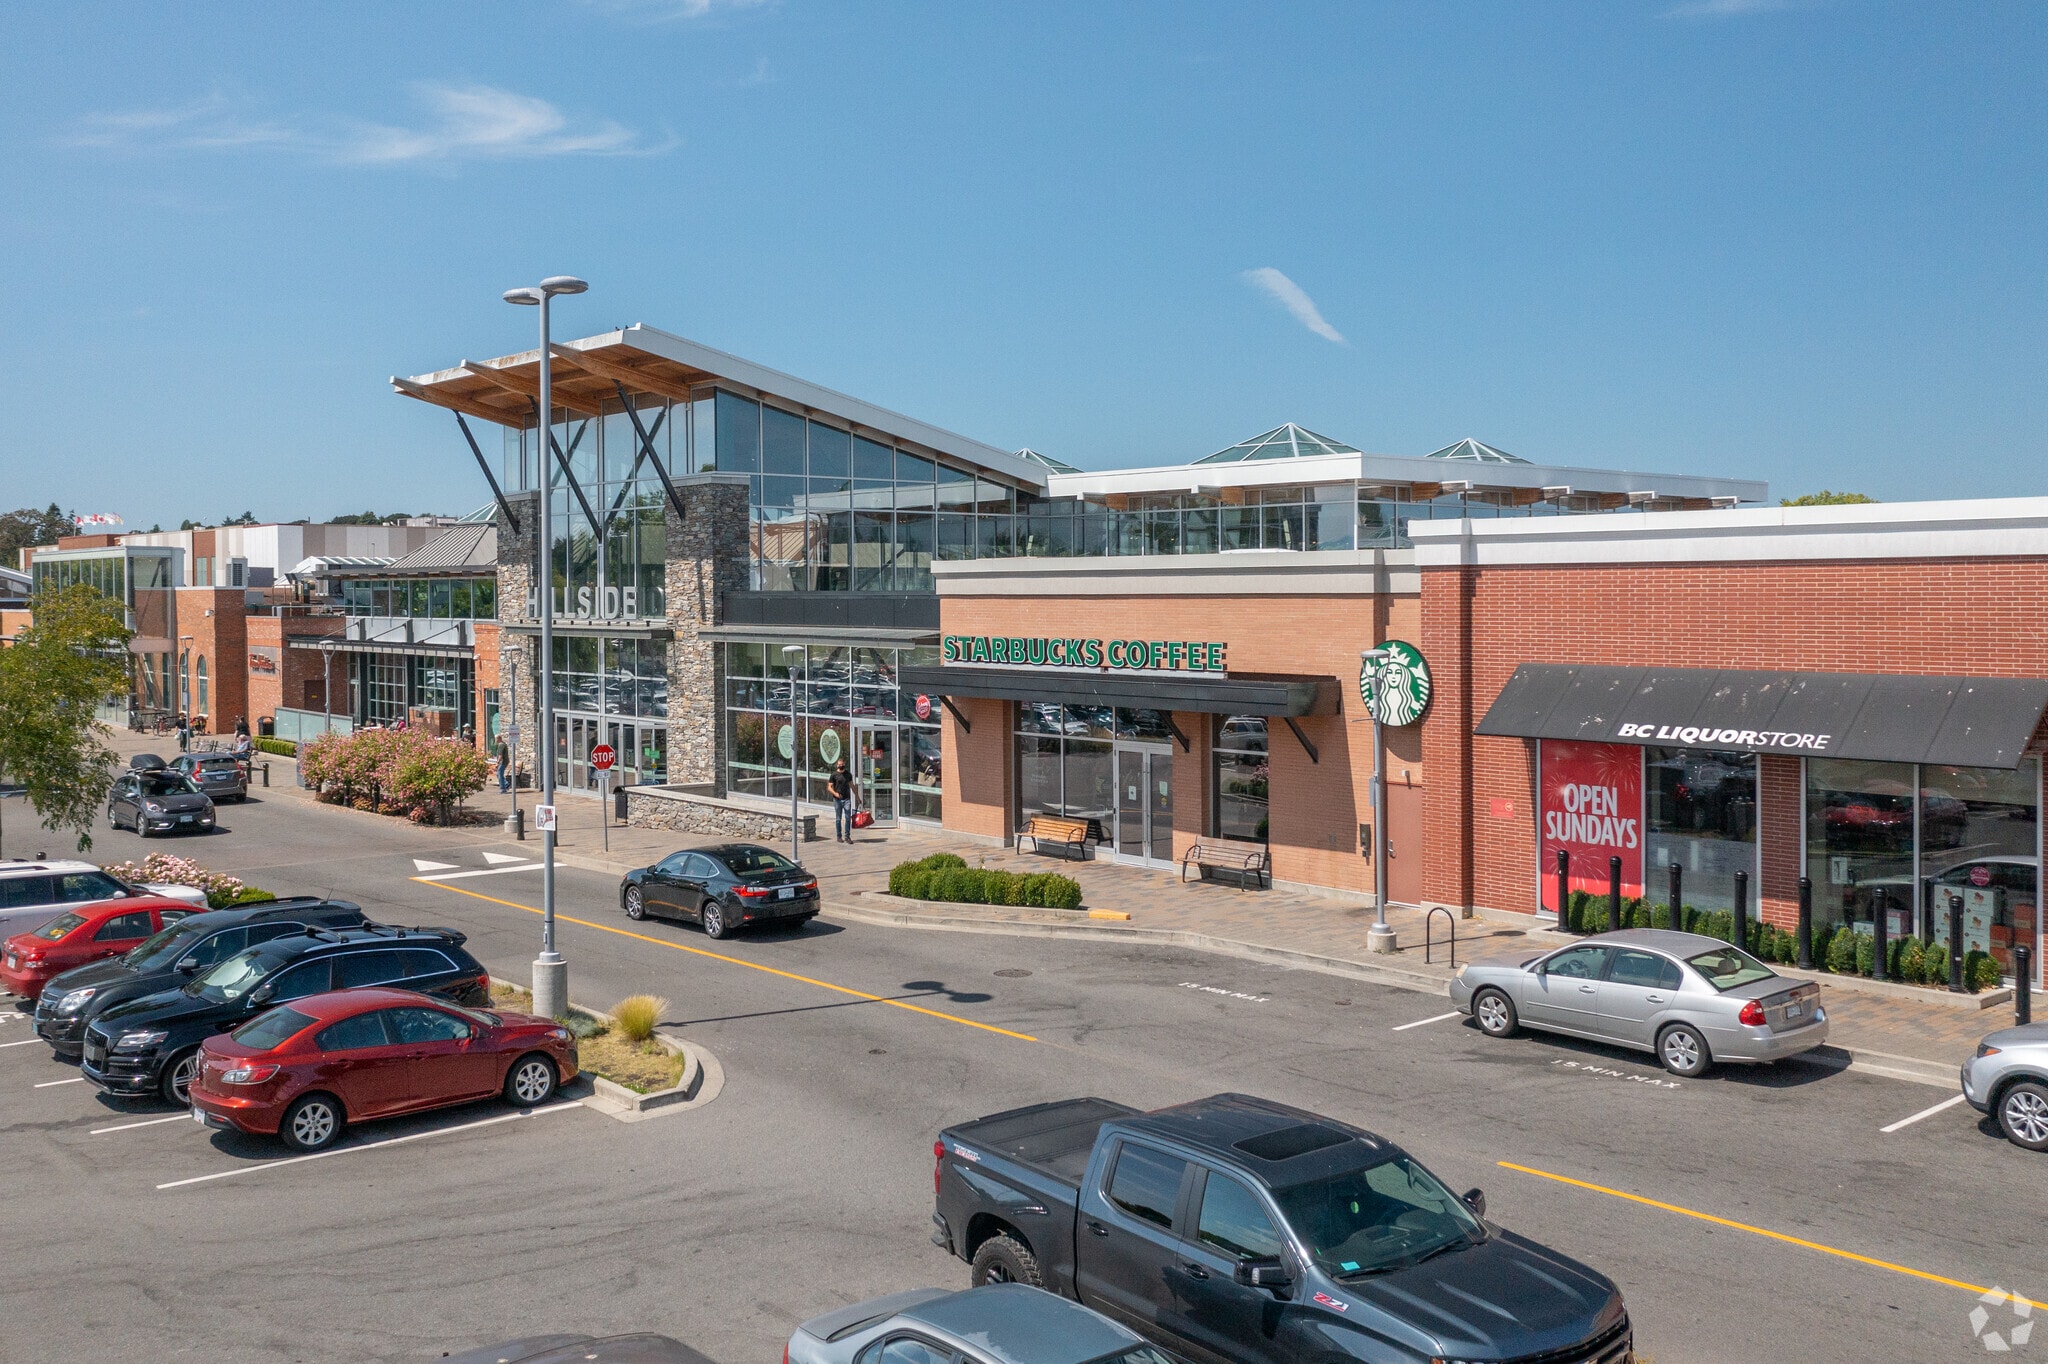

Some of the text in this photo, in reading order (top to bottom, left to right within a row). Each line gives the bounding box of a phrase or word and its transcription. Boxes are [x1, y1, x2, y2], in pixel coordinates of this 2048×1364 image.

[526, 586, 637, 620] HLLSIDE
[943, 635, 1225, 671] STARBUCKS COFFEE
[1618, 723, 1655, 738] BC
[592, 751, 614, 763] STOP
[1564, 783, 1618, 817] OPEN
[1546, 810, 1638, 849] SUNDAYS
[1551, 1059, 1680, 1088] 15 MIN MAX
[1312, 1291, 1349, 1312] Z71
